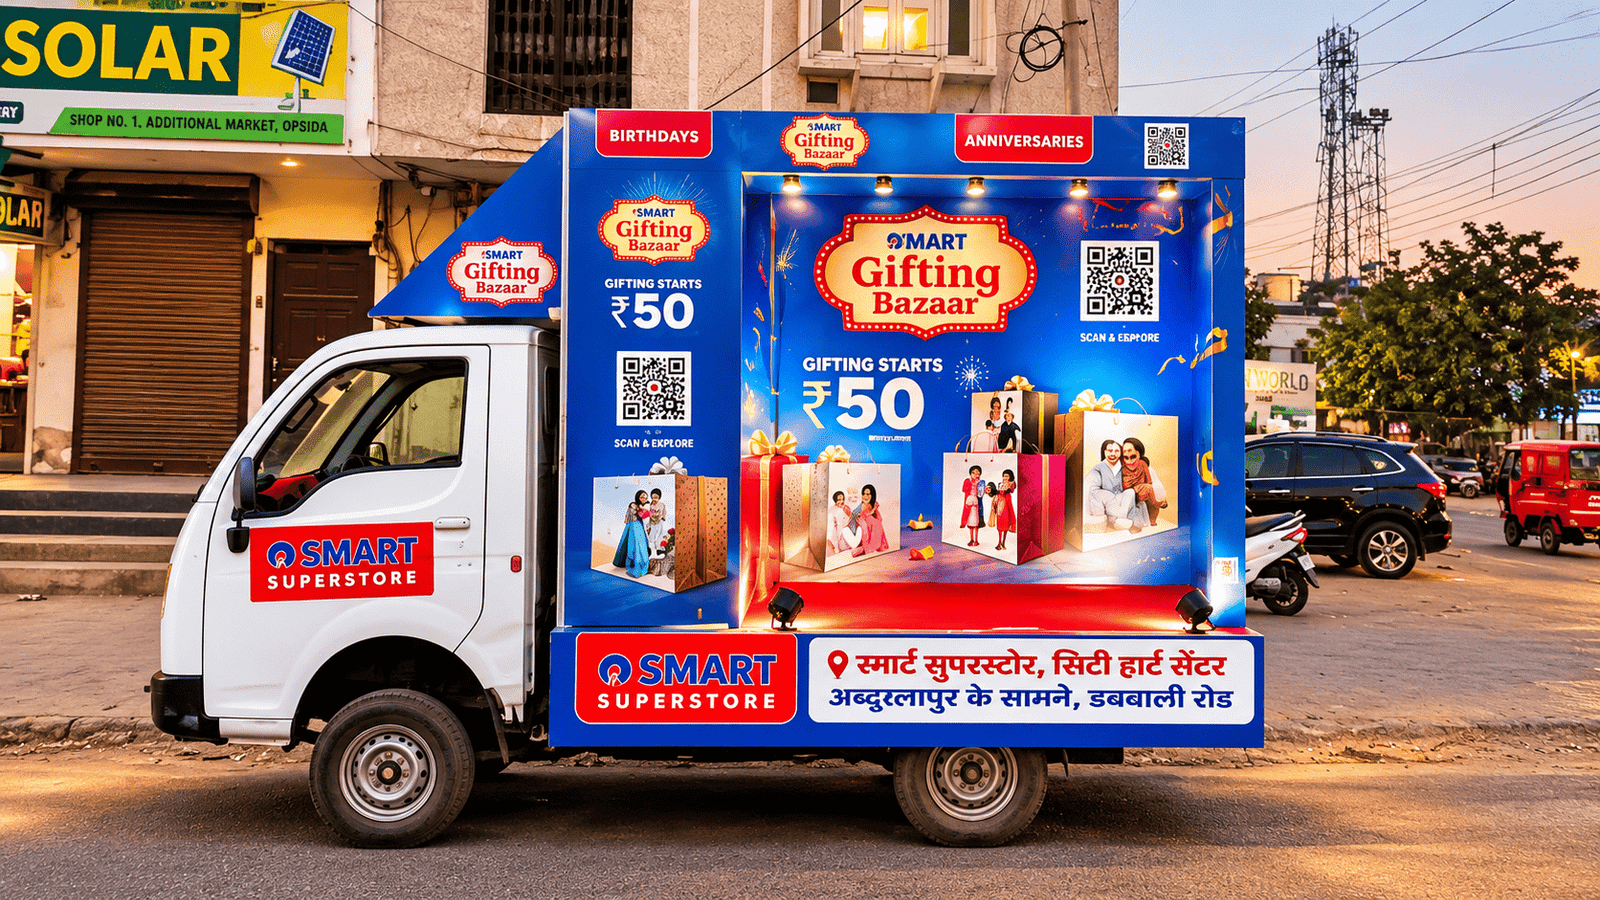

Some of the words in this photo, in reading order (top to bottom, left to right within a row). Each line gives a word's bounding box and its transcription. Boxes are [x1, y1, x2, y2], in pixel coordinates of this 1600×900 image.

[1, 19, 231, 82] SOLAR
[70, 114, 103, 126] SHOP
[107, 115, 127, 128] NO.
[146, 116, 222, 130] ADDITIONAL
[226, 119, 279, 134] MARKET,
[282, 121, 329, 134] OPSIDA
[610, 129, 699, 143] BIRTHDAYS
[794, 133, 854, 151] Gifting
[964, 134, 1084, 149] ANNIVERSARIES
[804, 149, 846, 159] Bazaar
[636, 208, 675, 218] SMART
[616, 220, 693, 242] Gifting
[628, 239, 681, 252] Bazaar
[485, 250, 523, 260] SMART
[464, 262, 540, 285] Gifting
[851, 254, 1001, 298] Gifting
[476, 281, 528, 294] Bazaar
[604, 278, 655, 289] GIFTING
[657, 278, 702, 289] STARTS
[872, 291, 979, 315] Bazaar
[1080, 332, 1106, 342] SCAN
[802, 357, 874, 373] GIFTING
[878, 357, 943, 373] STARTS
[1254, 369, 1308, 391] WORLD
[614, 438, 640, 448] SCAN
[300, 536, 419, 567] SMART
[267, 570, 417, 590] SUPERSTORE
[638, 653, 777, 686] SMART
[855, 648, 918, 675] स्मार्ट
[923, 648, 1045, 683] सुपरस्टोर,
[1052, 649, 1112, 676] सिटी
[1118, 649, 1164, 679] हार्ट
[1169, 649, 1228, 676] सेंटर
[597, 693, 775, 709] SUPERSTORE
[965, 683, 994, 706] के
[999, 684, 1081, 711] सामने,
[1087, 684, 1186, 708] डबबाली
[1191, 684, 1234, 708] रोड
